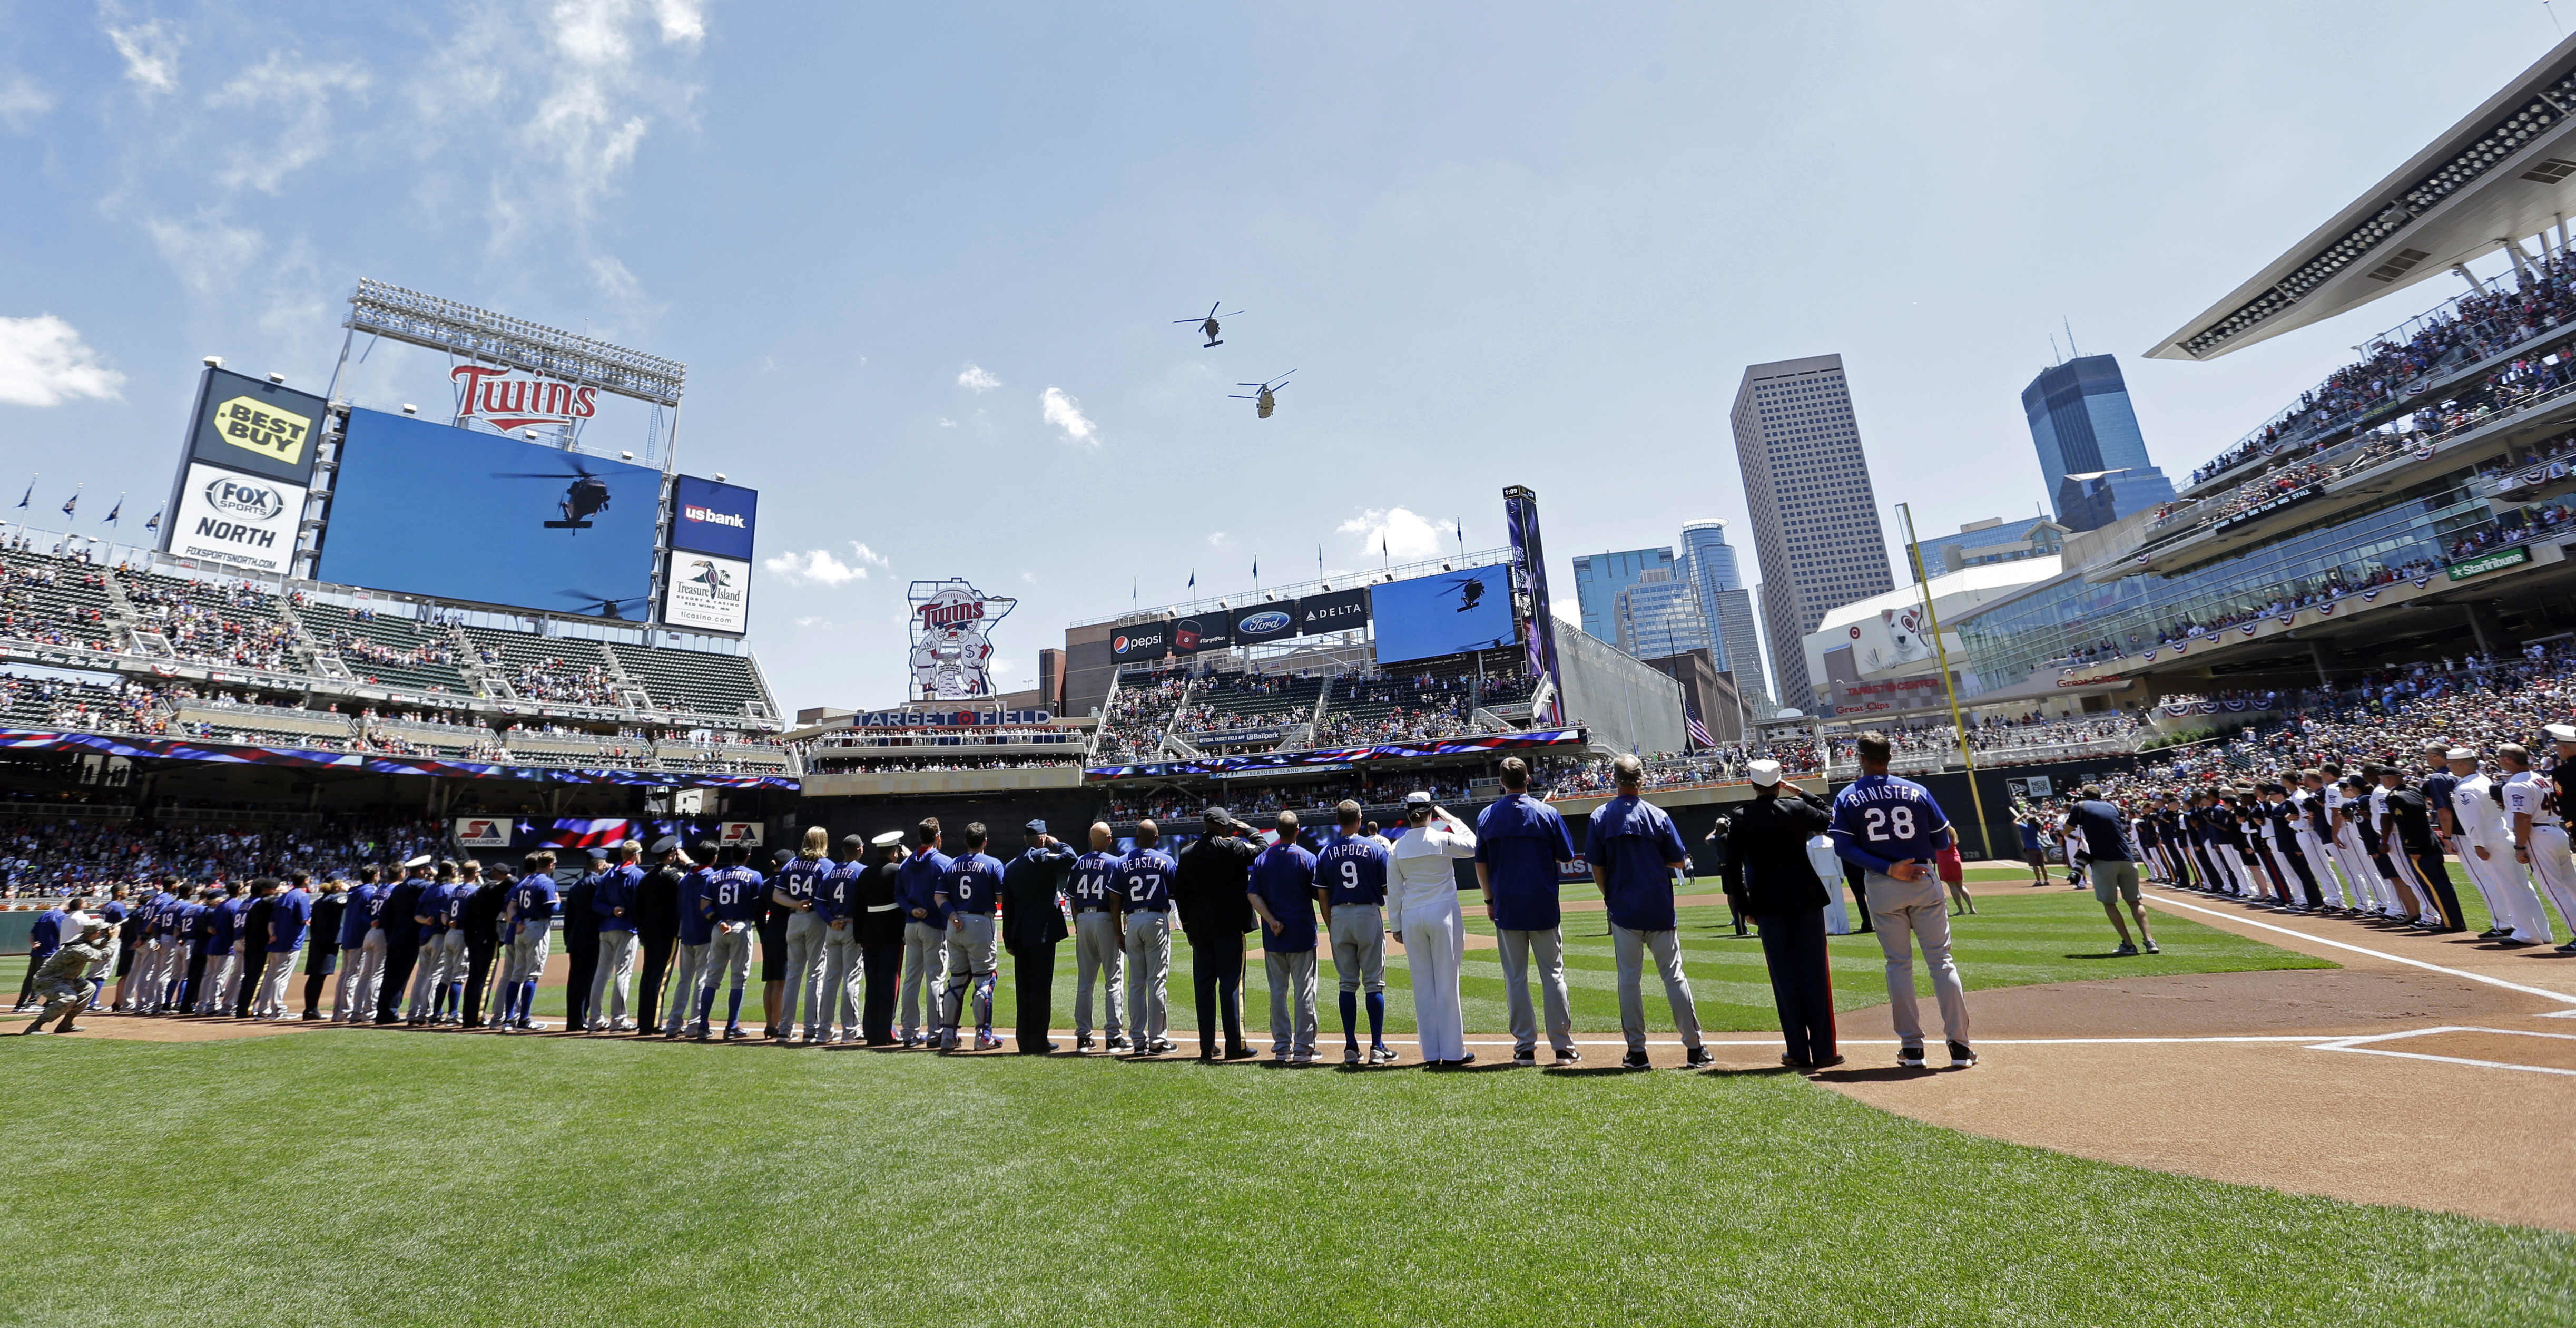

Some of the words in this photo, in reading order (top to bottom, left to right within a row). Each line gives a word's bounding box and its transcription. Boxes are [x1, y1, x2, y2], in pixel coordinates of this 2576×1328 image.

[449, 364, 598, 418] Twins
[229, 404, 306, 439] BEST
[227, 421, 294, 452] BUY
[221, 483, 269, 508] FOX
[219, 500, 267, 515] SPORTS
[2232, 513, 2246, 522] THAT
[2261, 502, 2276, 511] FLAG
[2292, 489, 2312, 500] STILL
[195, 517, 276, 548] NORTH
[185, 546, 277, 570] FOXSPORTSNORTH.COM
[2463, 554, 2523, 575] StarTribune
[676, 581, 710, 597] Treasure
[717, 588, 740, 601] Island
[681, 611, 732, 623] ticasino.com
[917, 599, 984, 631] Twins
[1320, 604, 1361, 618] DELTA
[1249, 615, 1280, 631] Ford
[1131, 632, 1162, 650] pepsi
[1199, 636, 1225, 644] #TargetRun
[1846, 685, 1885, 696] TARGET
[1897, 679, 1939, 690] CENTER
[2057, 679, 2089, 688] Great
[1836, 705, 1863, 714] Great
[1867, 702, 1890, 711] Clips
[856, 712, 954, 726] TARGET
[980, 710, 1051, 725] FIELD
[1847, 784, 1920, 807] BANISTER
[1864, 806, 1915, 842] 28
[1328, 843, 1370, 860] IAPOCE
[789, 860, 821, 873] GRIFFIN
[951, 861, 985, 873] WILSON
[1080, 858, 1106, 870] OWEN
[1122, 856, 1167, 873] BEASLEY
[1560, 859, 1592, 873] us
[712, 870, 753, 884] CHIRINOS
[831, 868, 855, 879] ORTIZ
[1341, 861, 1358, 888] 9
[790, 874, 813, 896] 64
[834, 882, 844, 903] 4
[960, 876, 971, 899] 6
[1077, 874, 1104, 900] 44
[1129, 874, 1160, 901] 27
[519, 890, 531, 909] 16
[719, 883, 740, 905] 61
[371, 899, 384, 915] 37
[450, 900, 459, 917] 8
[161, 912, 173, 927] 19
[182, 917, 193, 932] 12
[233, 912, 248, 929] 84
